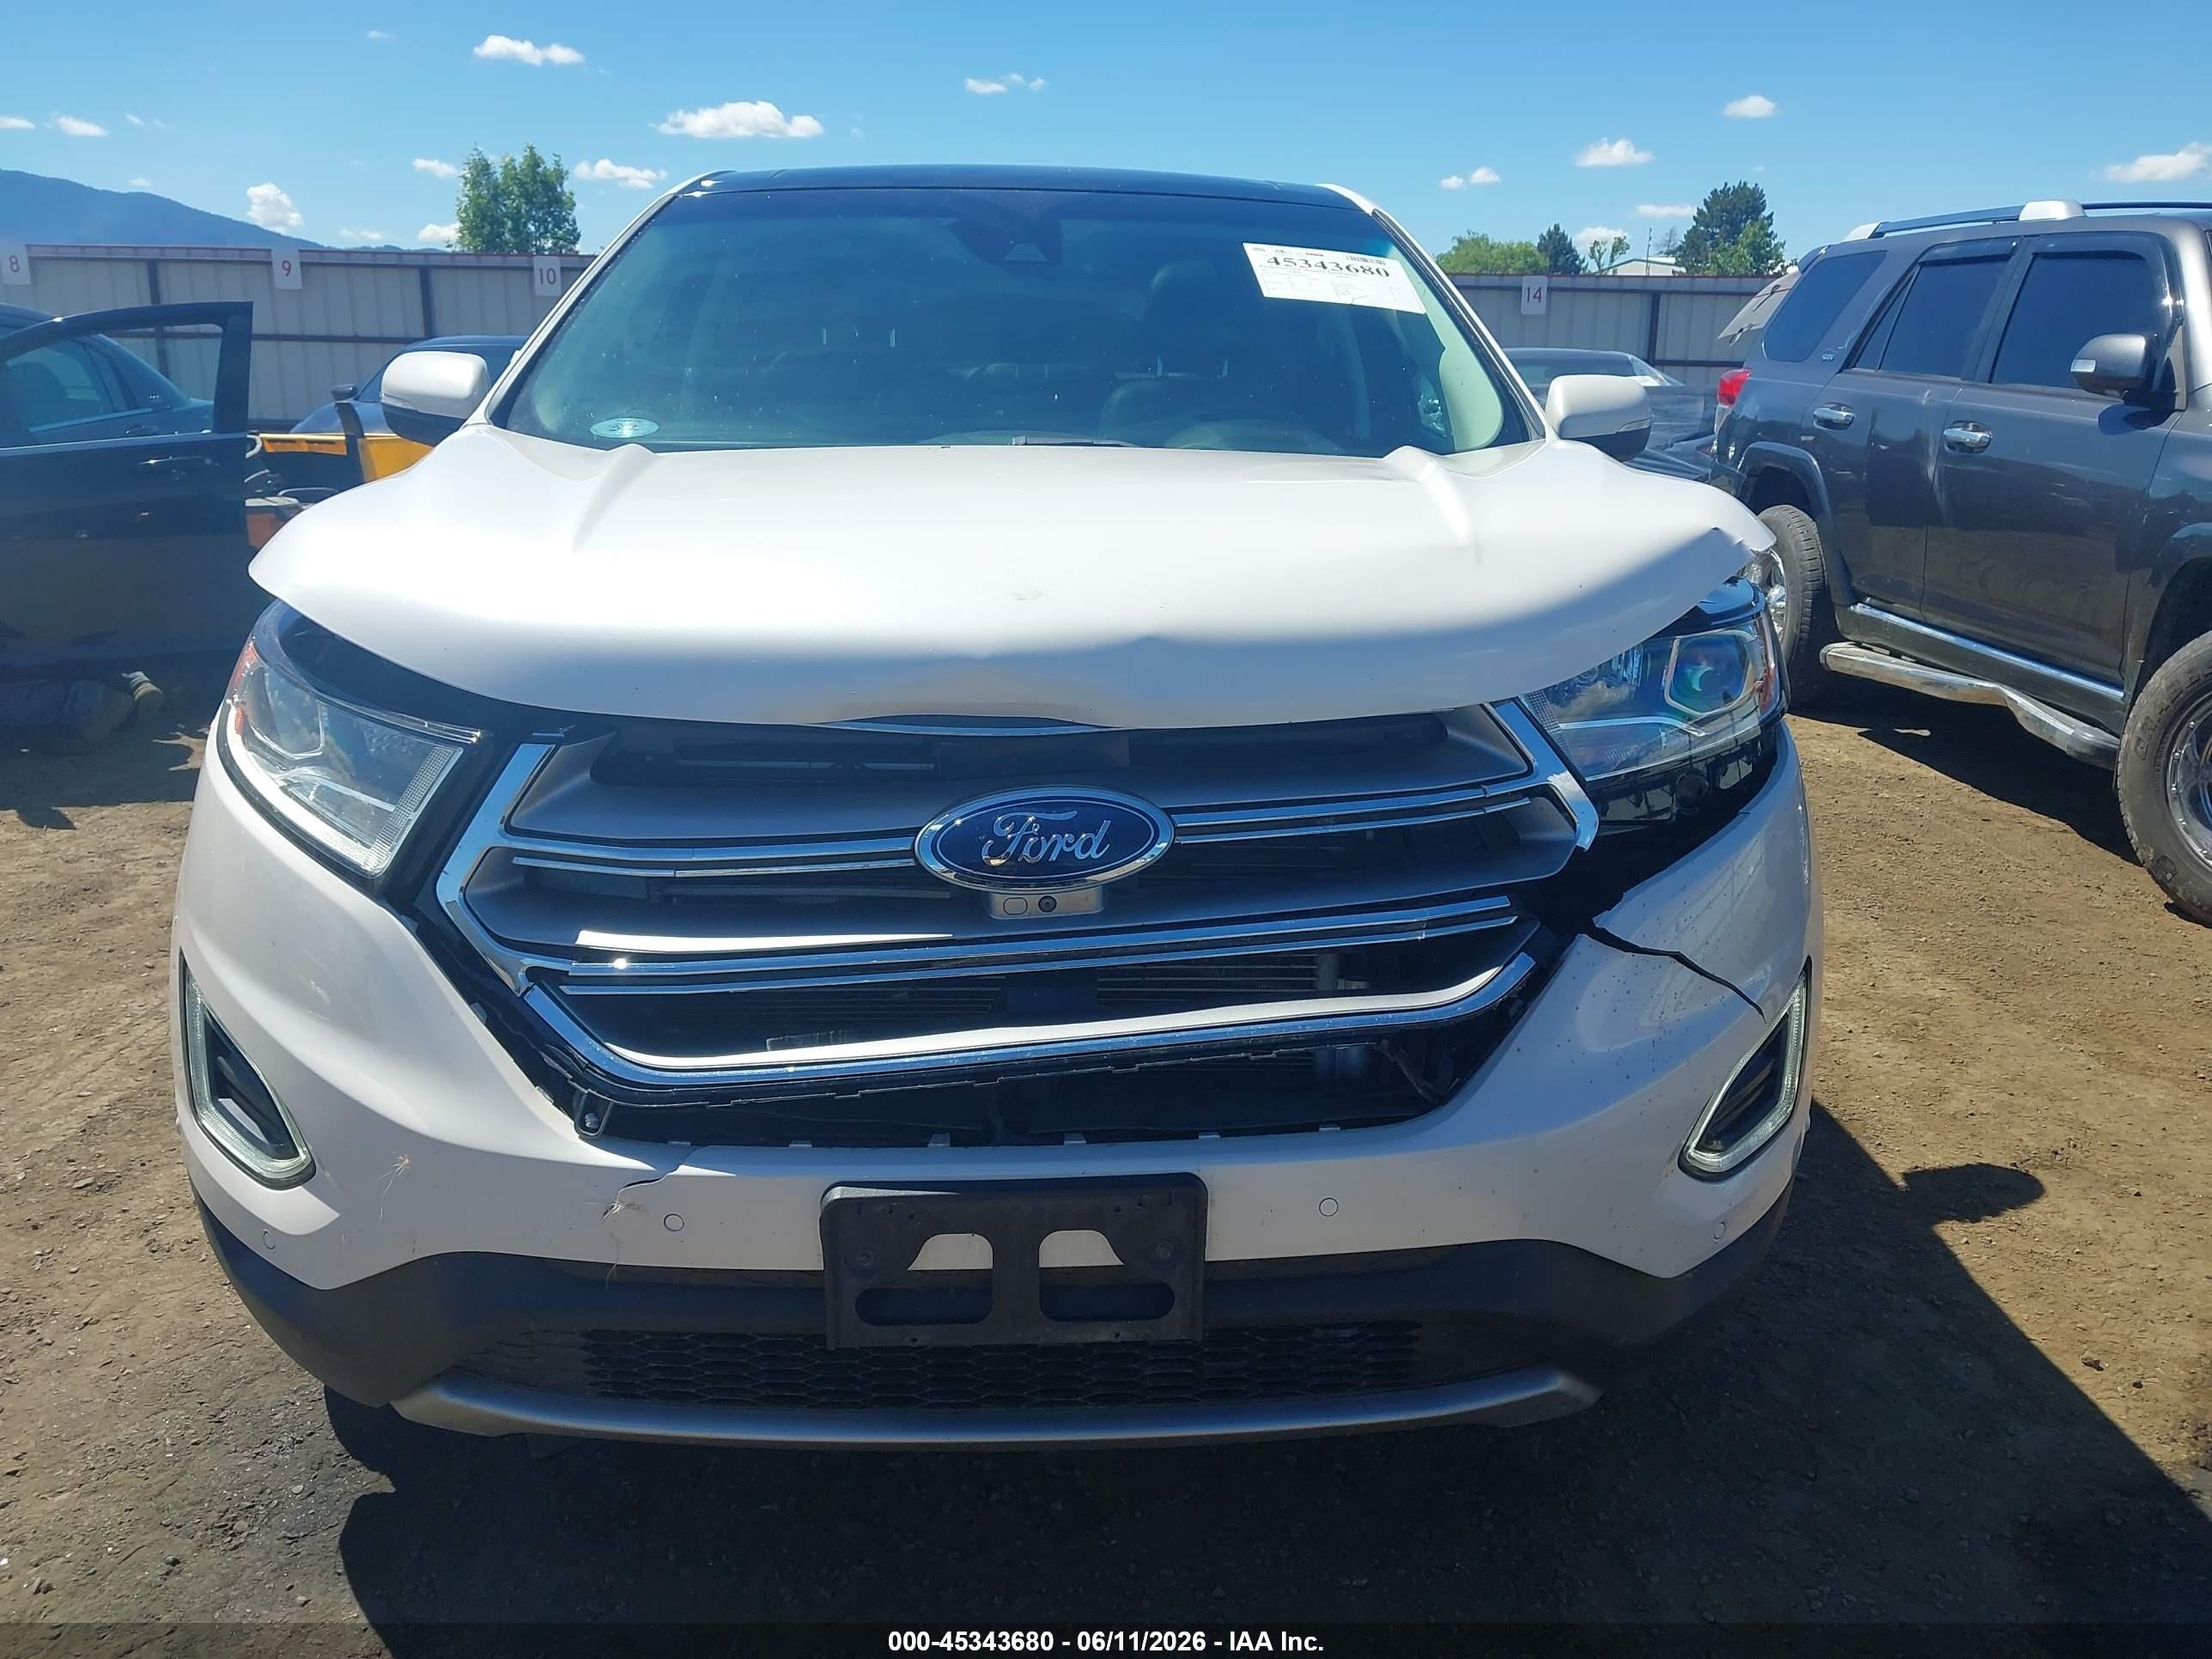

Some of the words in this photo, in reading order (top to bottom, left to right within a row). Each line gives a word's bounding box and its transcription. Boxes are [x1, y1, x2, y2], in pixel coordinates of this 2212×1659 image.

[9, 254, 20, 273] 8
[282, 259, 292, 276] 9
[1267, 256, 1391, 278] 45343680
[539, 267, 556, 285] 10
[1527, 286, 1542, 303] 14
[981, 810, 1112, 866] Ford
